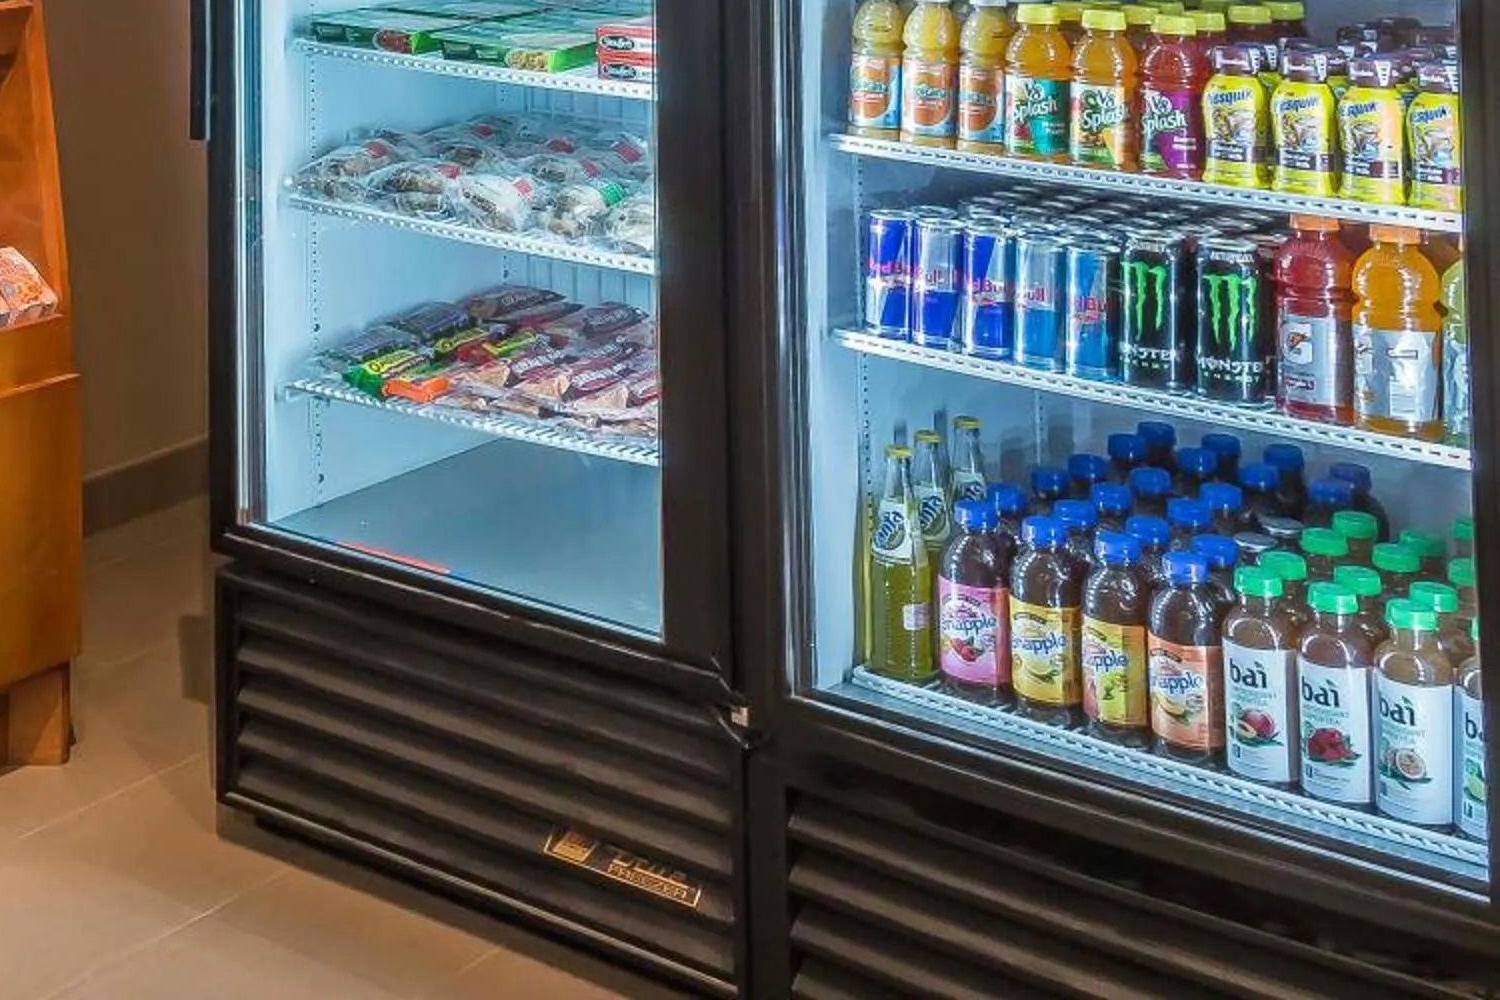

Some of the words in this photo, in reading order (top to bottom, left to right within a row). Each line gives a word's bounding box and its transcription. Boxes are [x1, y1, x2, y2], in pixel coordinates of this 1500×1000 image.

[1012, 96, 1058, 123] Splash
[1081, 102, 1128, 130] Splash
[1229, 657, 1268, 689] bai
[1301, 675, 1340, 708] bai
